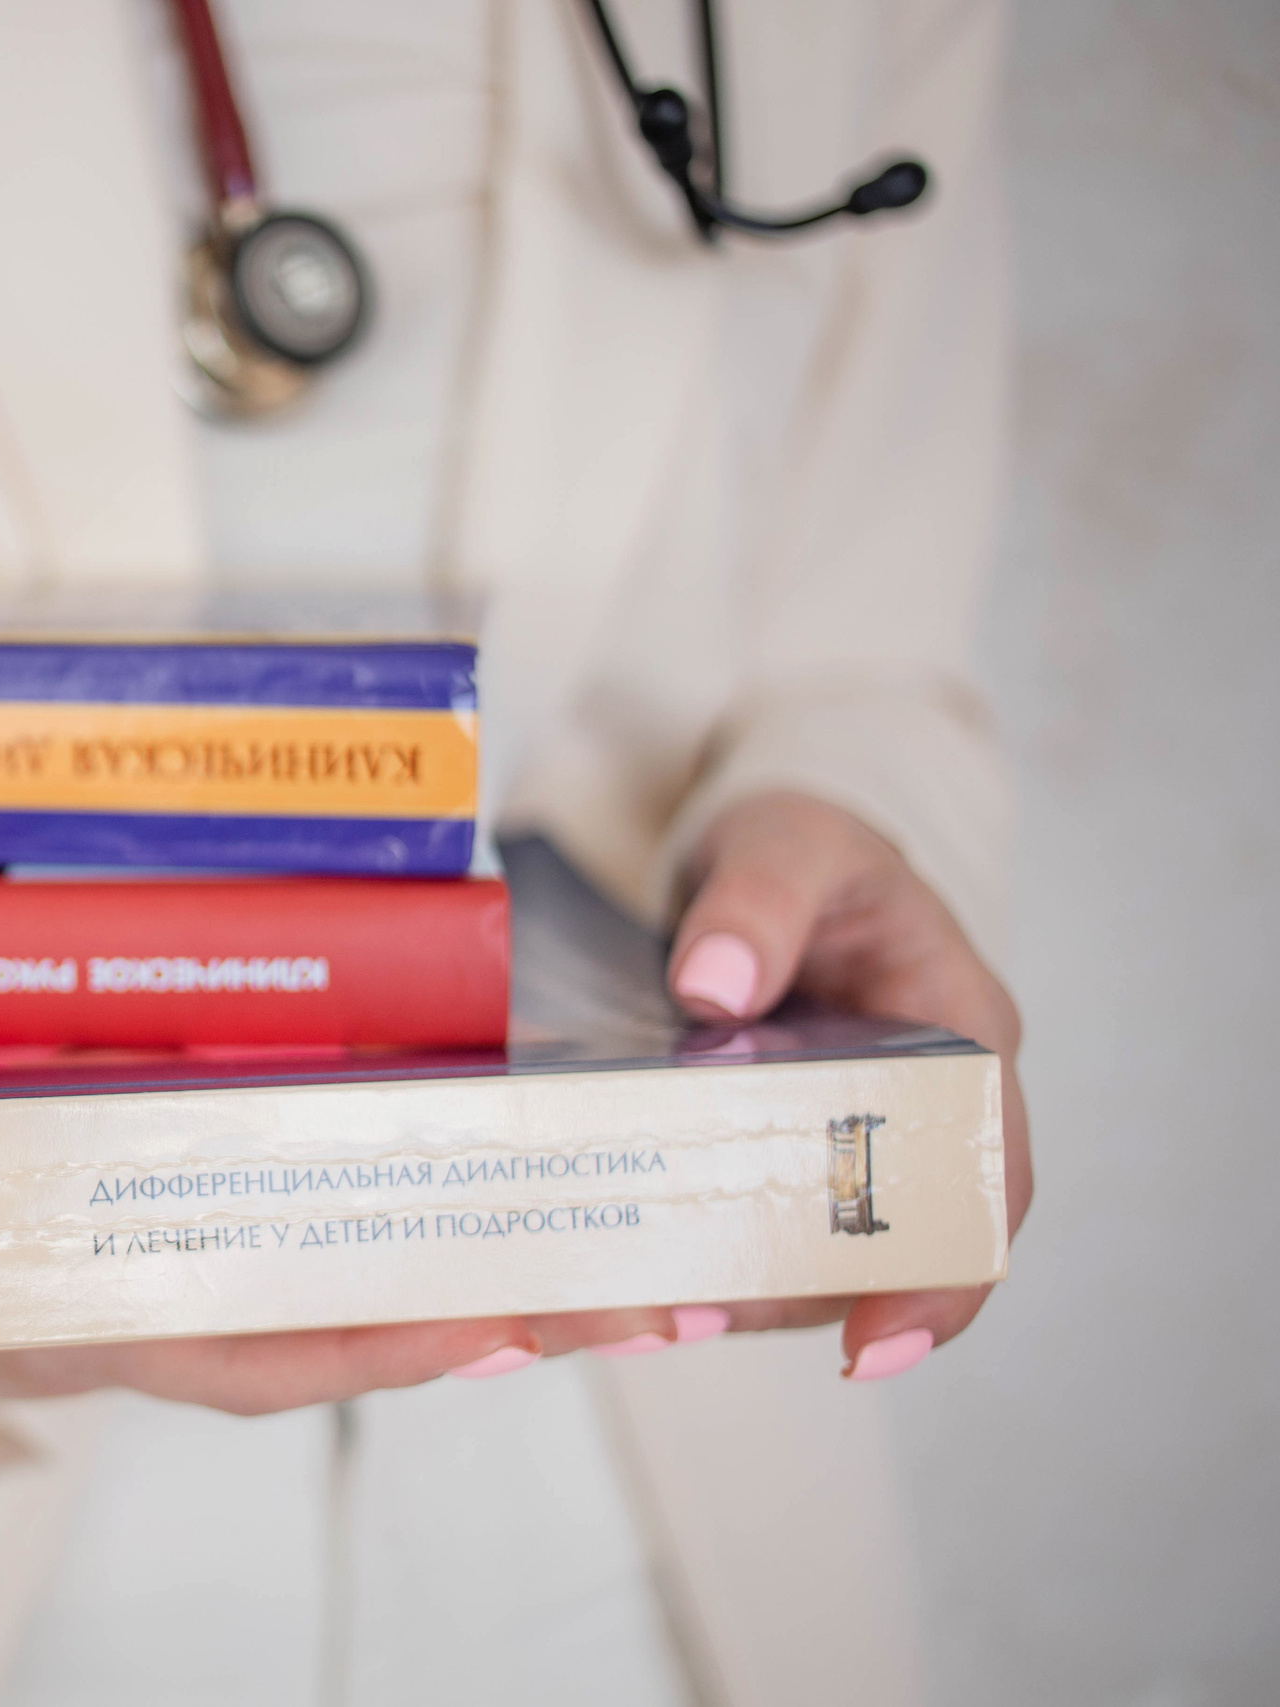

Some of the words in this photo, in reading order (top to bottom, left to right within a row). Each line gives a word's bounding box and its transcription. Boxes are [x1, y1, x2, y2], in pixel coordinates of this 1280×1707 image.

[71, 735, 423, 786] КЛИНИЧЕСКАЯ
[86, 956, 330, 993] КЛИНИЧЕСКОЕ
[89, 1161, 433, 1207] ДИФФЕРЕНЦИАЛЬНАЯ
[442, 1150, 667, 1188] ДИАГНОСТИКА
[92, 1232, 116, 1256] И
[126, 1223, 261, 1254] ЛЕЧЕНИЕ
[271, 1223, 291, 1249] У
[299, 1212, 393, 1250] ДЕТЕЙ
[403, 1215, 424, 1239] И
[434, 1203, 641, 1239] ПОДРОСТКОВ
